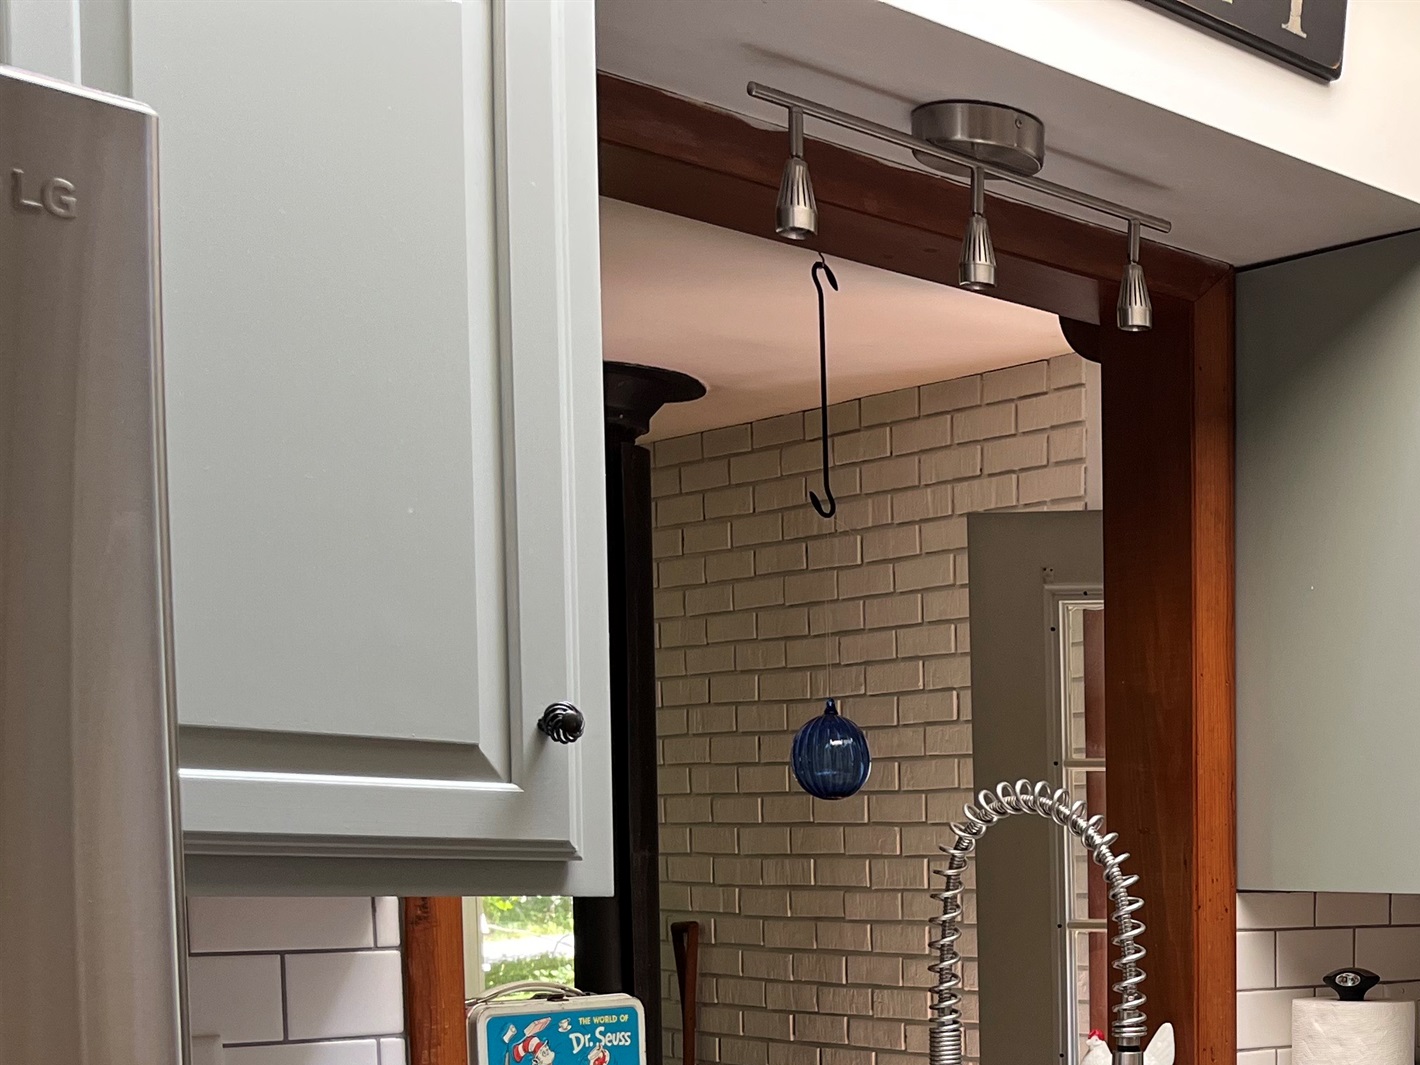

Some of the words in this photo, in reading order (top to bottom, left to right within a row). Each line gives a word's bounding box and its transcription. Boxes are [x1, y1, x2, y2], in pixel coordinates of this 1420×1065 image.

[11, 168, 77, 219] LG
[578, 1017, 591, 1025] THE
[593, 1015, 617, 1024] WORLD
[619, 1014, 629, 1022] OF
[569, 1032, 593, 1054] Dr.
[595, 1026, 631, 1047] Seuss
